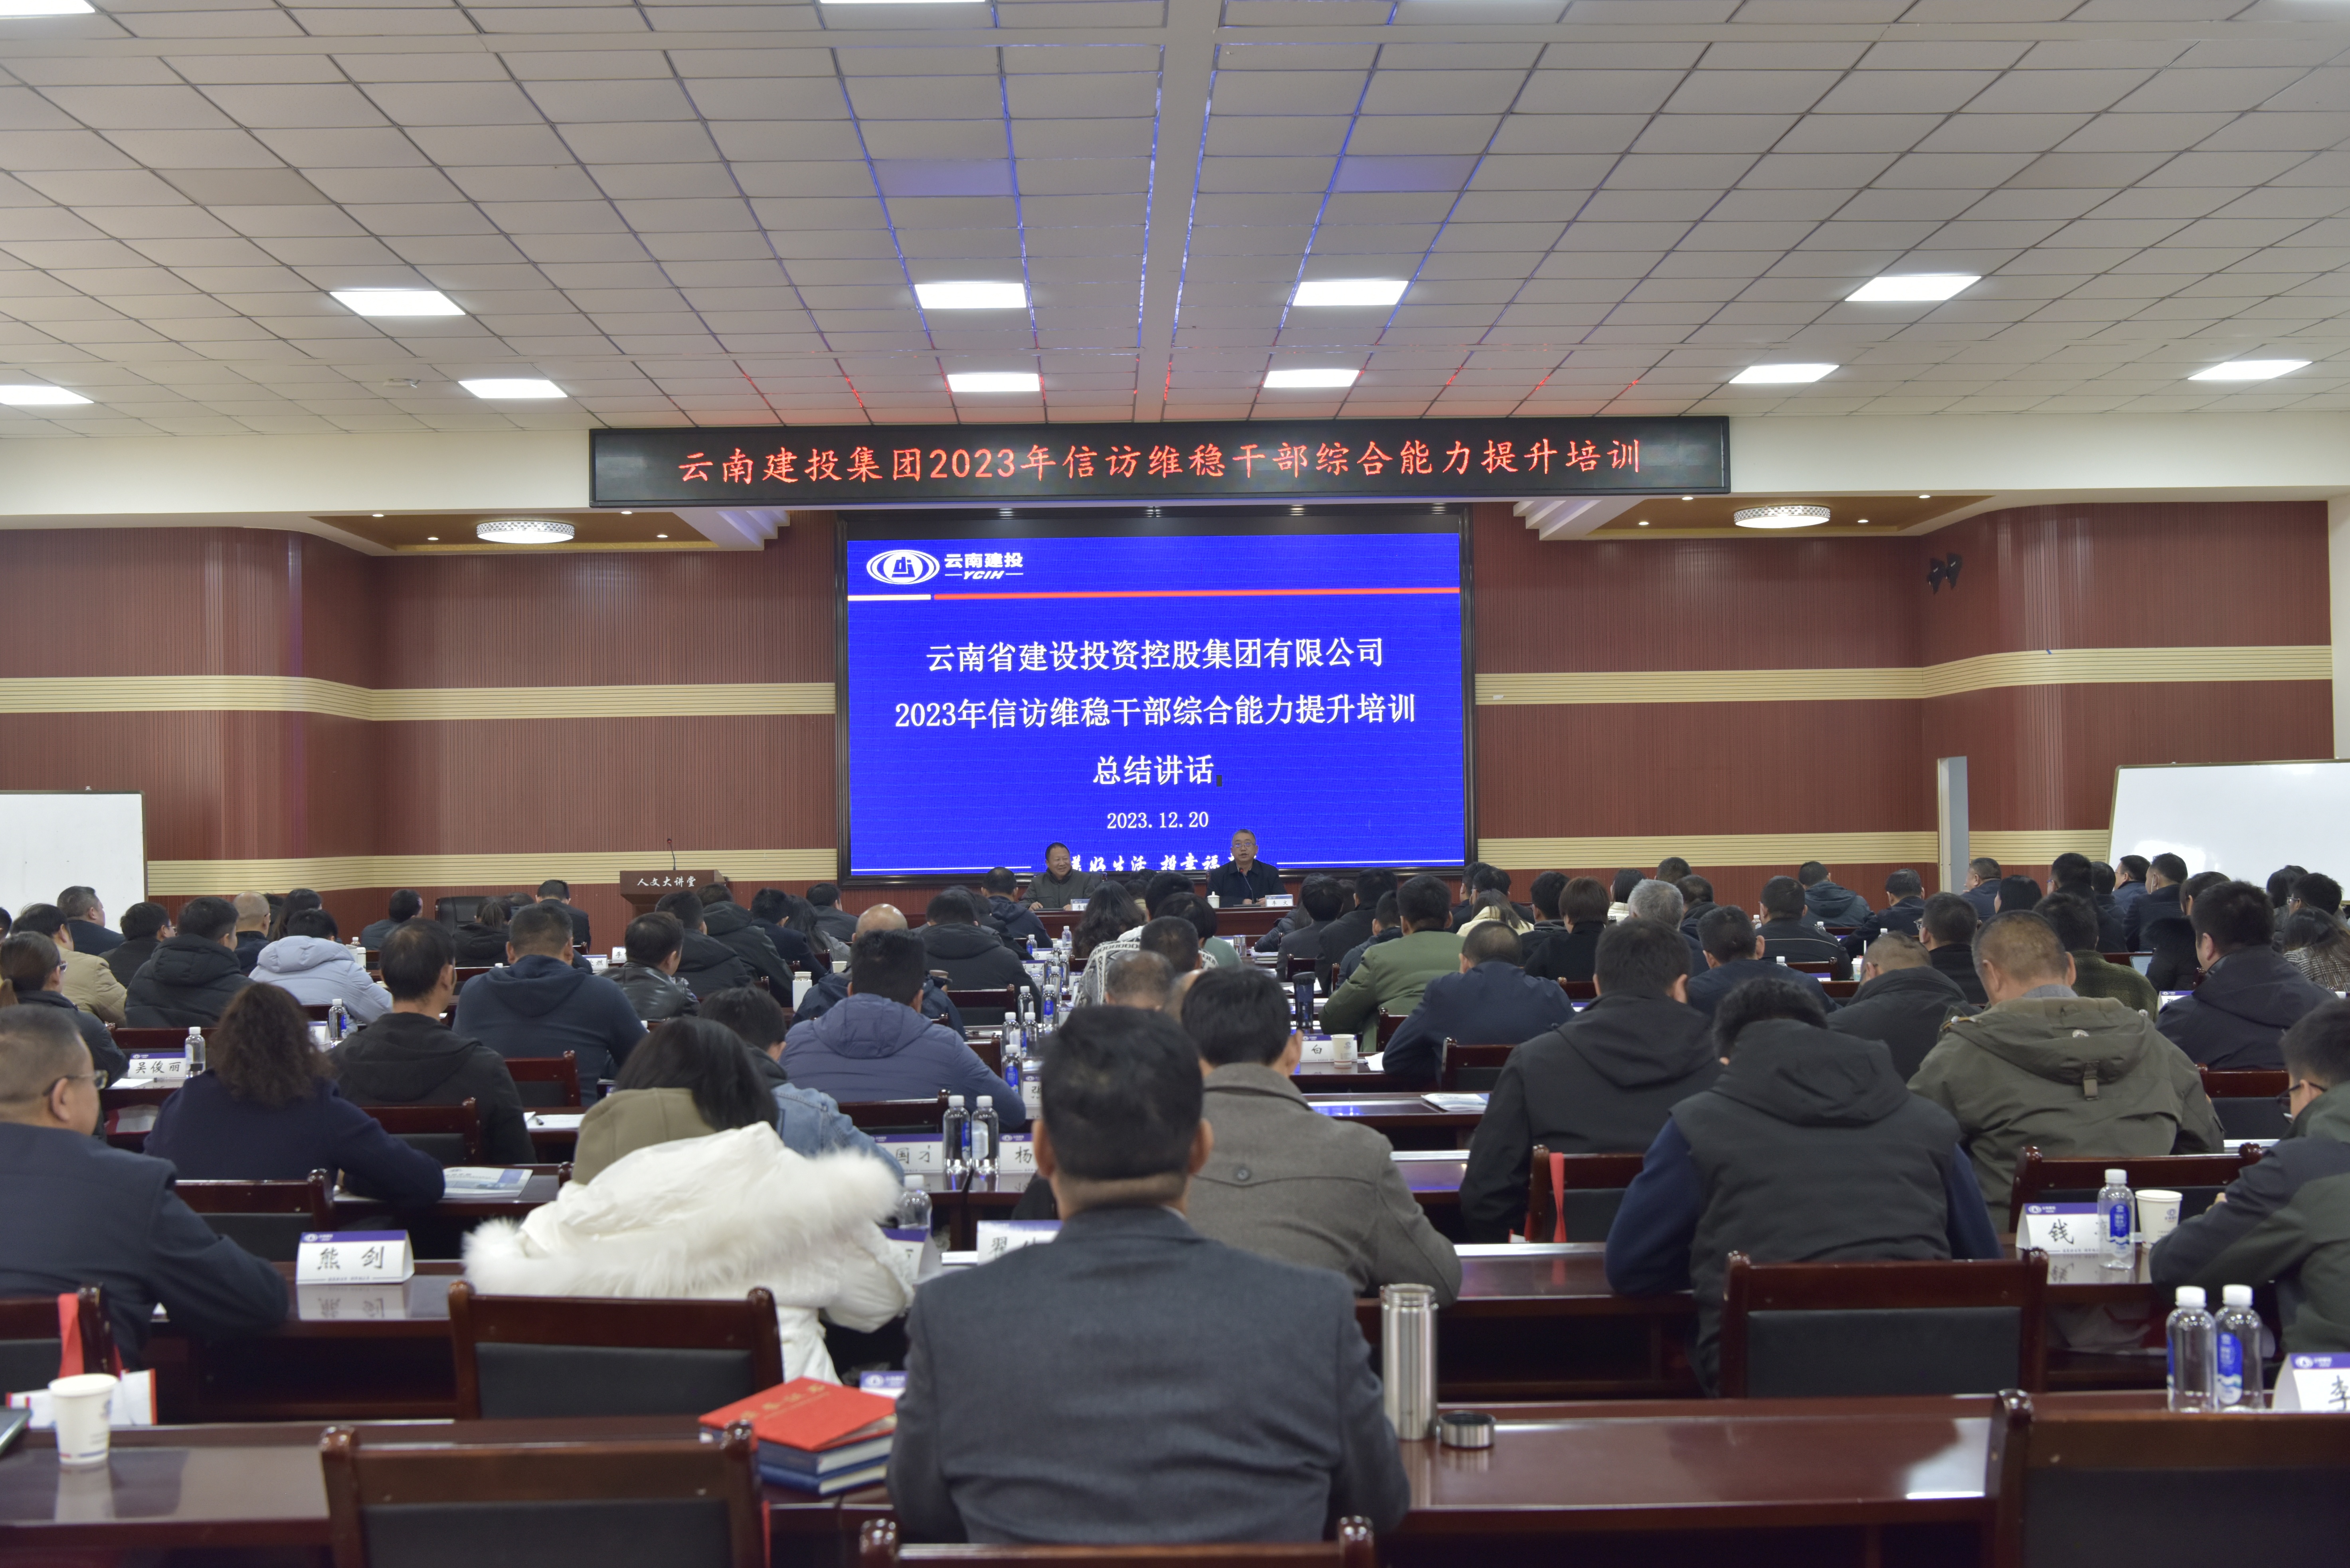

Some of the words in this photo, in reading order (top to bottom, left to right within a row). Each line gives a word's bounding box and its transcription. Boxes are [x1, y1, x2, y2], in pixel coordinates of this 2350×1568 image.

[678, 439, 1640, 484] 云南建投集团2023年信访维稳干部综合能力提升培训
[944, 552, 1023, 568] 云南建投
[963, 571, 1005, 580] YCIH
[926, 637, 1383, 672] 云南省建设投资控股集团有限公司
[895, 693, 1415, 729] 2023年信访维稳干部综合能力提升培训
[1093, 754, 1214, 785] 总结讲话
[1107, 811, 1209, 829] 2023.12.20
[1161, 852, 1234, 870] 投幸福
[637, 876, 696, 887] 人文大讲堂
[136, 1060, 181, 1074] 吴俊丽
[317, 1246, 385, 1270] 熊剑
